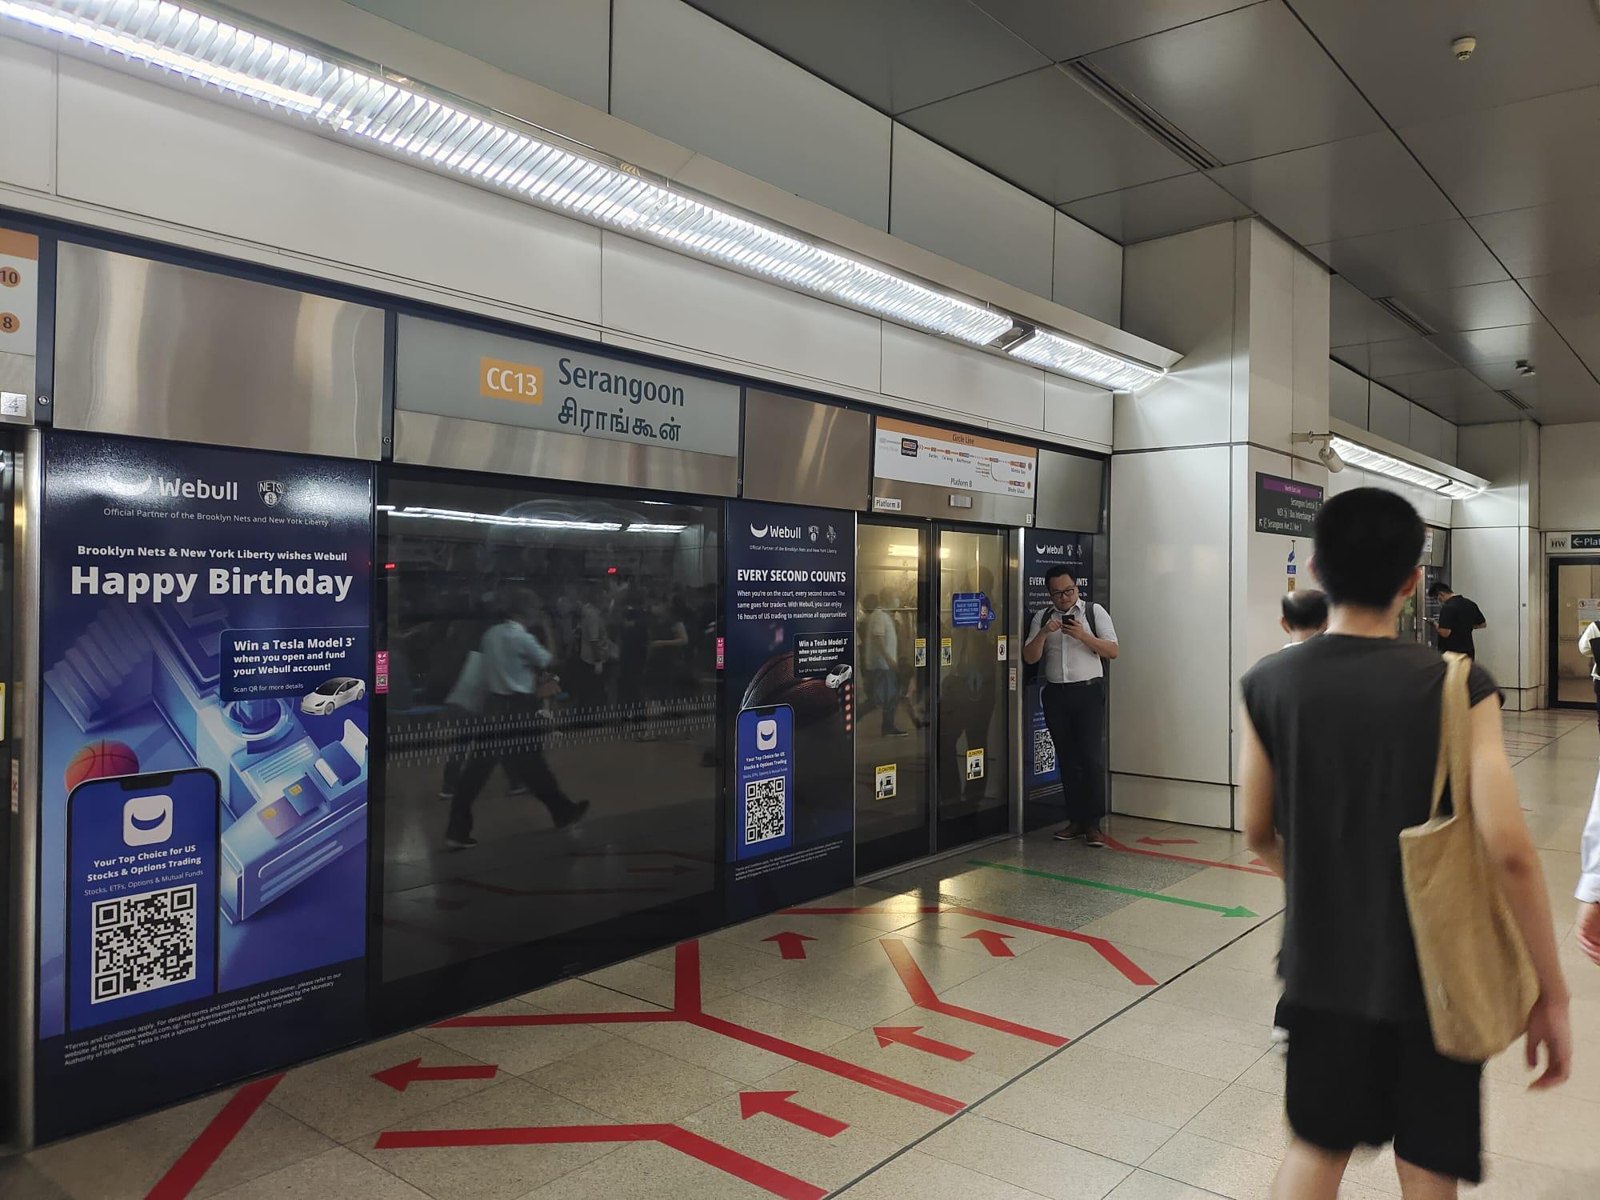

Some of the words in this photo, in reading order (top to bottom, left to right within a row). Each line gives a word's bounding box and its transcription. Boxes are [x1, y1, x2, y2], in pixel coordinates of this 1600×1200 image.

[487, 367, 537, 396] CC13
[558, 358, 684, 406] Serangoon
[558, 397, 681, 441] சிராங்கூன்
[158, 477, 238, 500] Webull
[259, 482, 283, 494] NETS
[951, 477, 968, 487] Platform
[876, 499, 896, 509] Platform
[104, 508, 134, 517] Official
[137, 509, 168, 518] Partner
[171, 511, 179, 519] of
[181, 512, 194, 520] the
[197, 513, 231, 522] Brooklyn
[269, 516, 285, 524] New
[286, 517, 302, 525] York
[304, 518, 329, 527] Liberty
[770, 525, 801, 539] Webull
[1046, 545, 1063, 555] Webull
[1552, 540, 1566, 548] HW
[78, 545, 134, 558] Brooklyn
[138, 547, 165, 556] Nets
[168, 548, 177, 557] &
[181, 548, 207, 558] New
[209, 549, 235, 558] York
[238, 550, 275, 561] Liberty
[277, 551, 312, 560] wishes
[314, 552, 347, 561] Webull
[738, 570, 768, 581] EVERY
[770, 570, 808, 582] SECOND
[811, 571, 846, 582] COUNTS
[1029, 577, 1045, 586] EVERY
[72, 566, 198, 603] Happy
[209, 567, 353, 602] Birthday
[234, 640, 258, 651] Win
[273, 640, 304, 650] Tesla
[308, 638, 342, 648] Model
[234, 654, 260, 662] when
[263, 654, 280, 664] you
[282, 653, 304, 662] open
[307, 652, 323, 660] and
[325, 650, 346, 659] fund
[233, 668, 256, 678] your
[258, 664, 290, 674] Webull
[292, 663, 331, 672] account!
[94, 859, 116, 868] Your
[118, 855, 135, 864] Top
[138, 851, 168, 861] Choice
[170, 847, 182, 856] for
[87, 871, 118, 882] Stocks
[122, 868, 128, 876] &
[131, 863, 166, 875] Options
[169, 856, 202, 868] Trading
[84, 888, 107, 896] Stocks,
[110, 883, 126, 892] ETFs,
[128, 878, 153, 888] Options
[162, 874, 184, 882] Mutual
